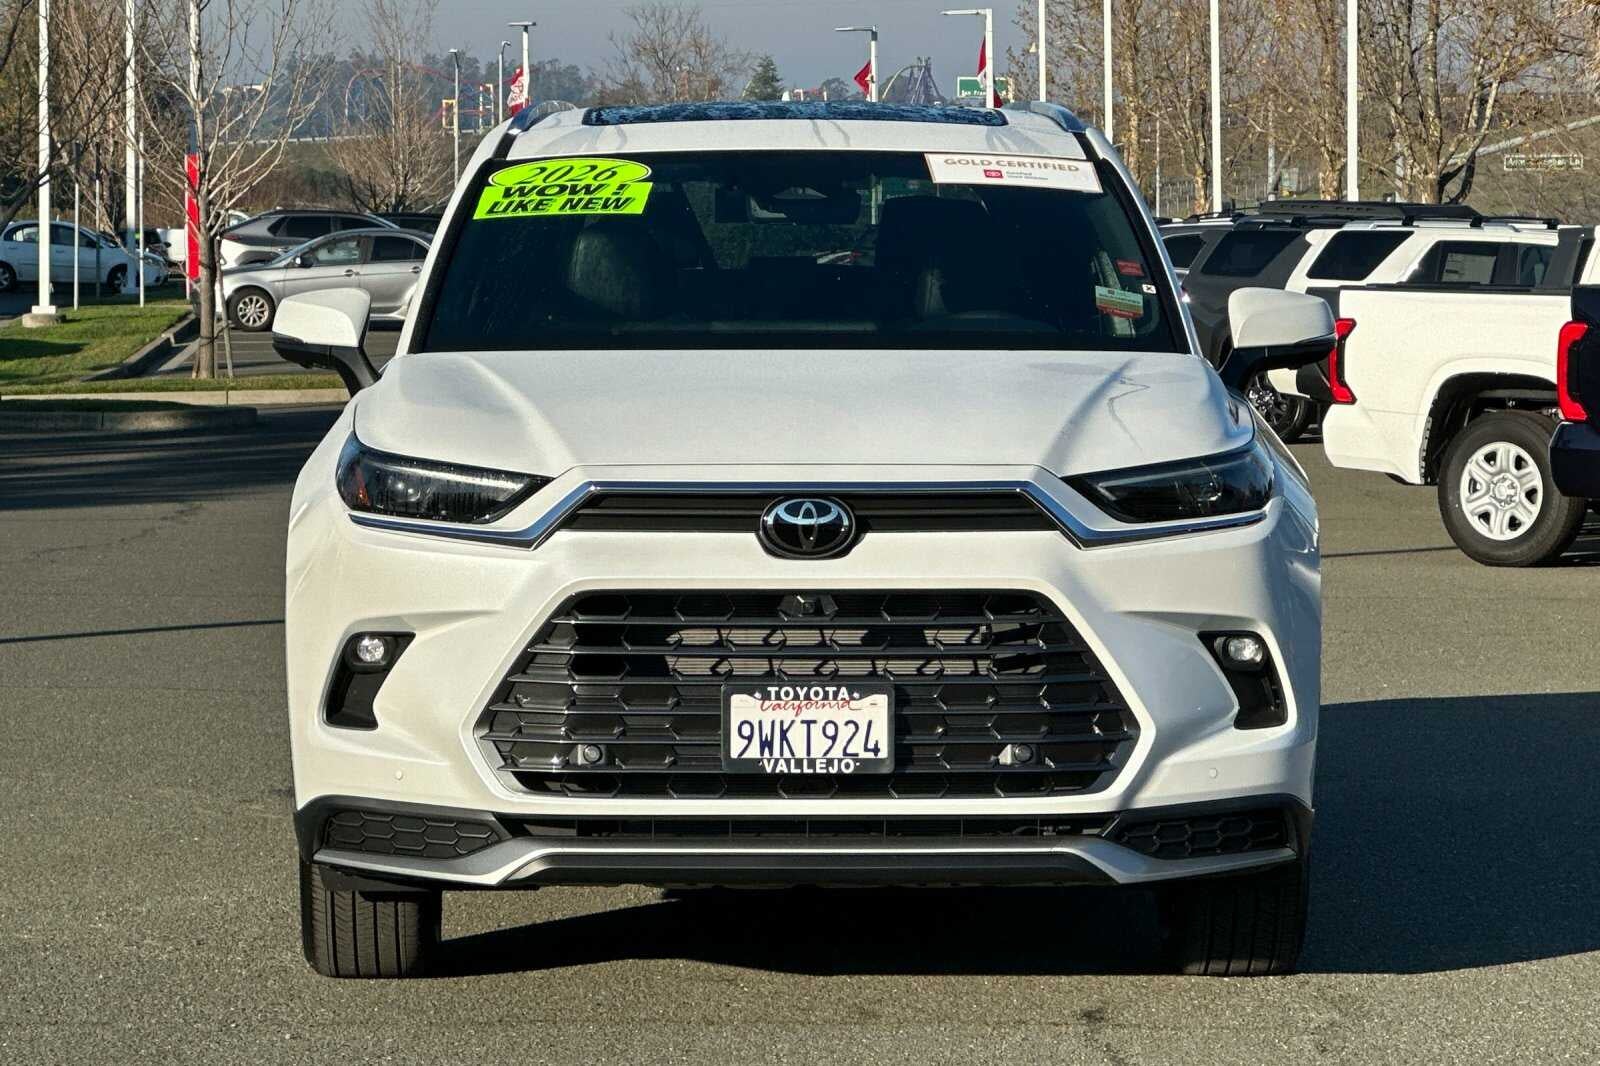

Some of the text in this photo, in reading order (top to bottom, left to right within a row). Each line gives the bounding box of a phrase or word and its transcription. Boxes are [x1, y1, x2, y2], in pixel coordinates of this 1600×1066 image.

[943, 158, 1080, 172] GOLD CERTIFIED
[516, 164, 631, 185] 2026
[486, 197, 636, 214] LIKE NEW
[767, 686, 849, 701] TOYOTA
[737, 719, 881, 758] 9WKT924
[762, 759, 855, 774] VALLEJO
